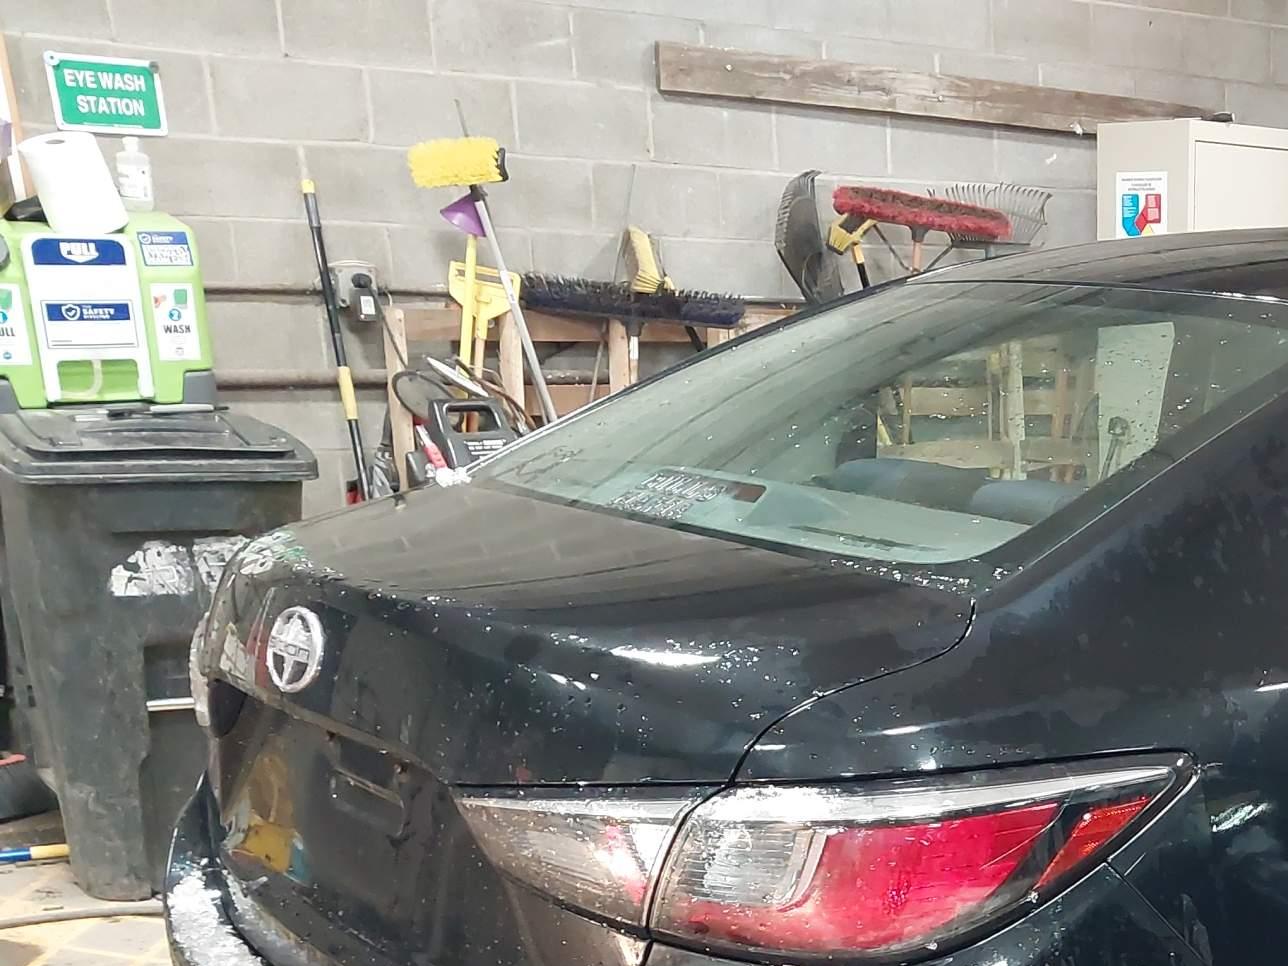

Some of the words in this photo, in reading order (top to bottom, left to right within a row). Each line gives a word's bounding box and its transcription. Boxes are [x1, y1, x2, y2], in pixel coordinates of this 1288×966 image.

[63, 68, 98, 89] EYE
[97, 71, 146, 92] WASH
[76, 95, 145, 116] STATION
[163, 324, 191, 334] WASH
